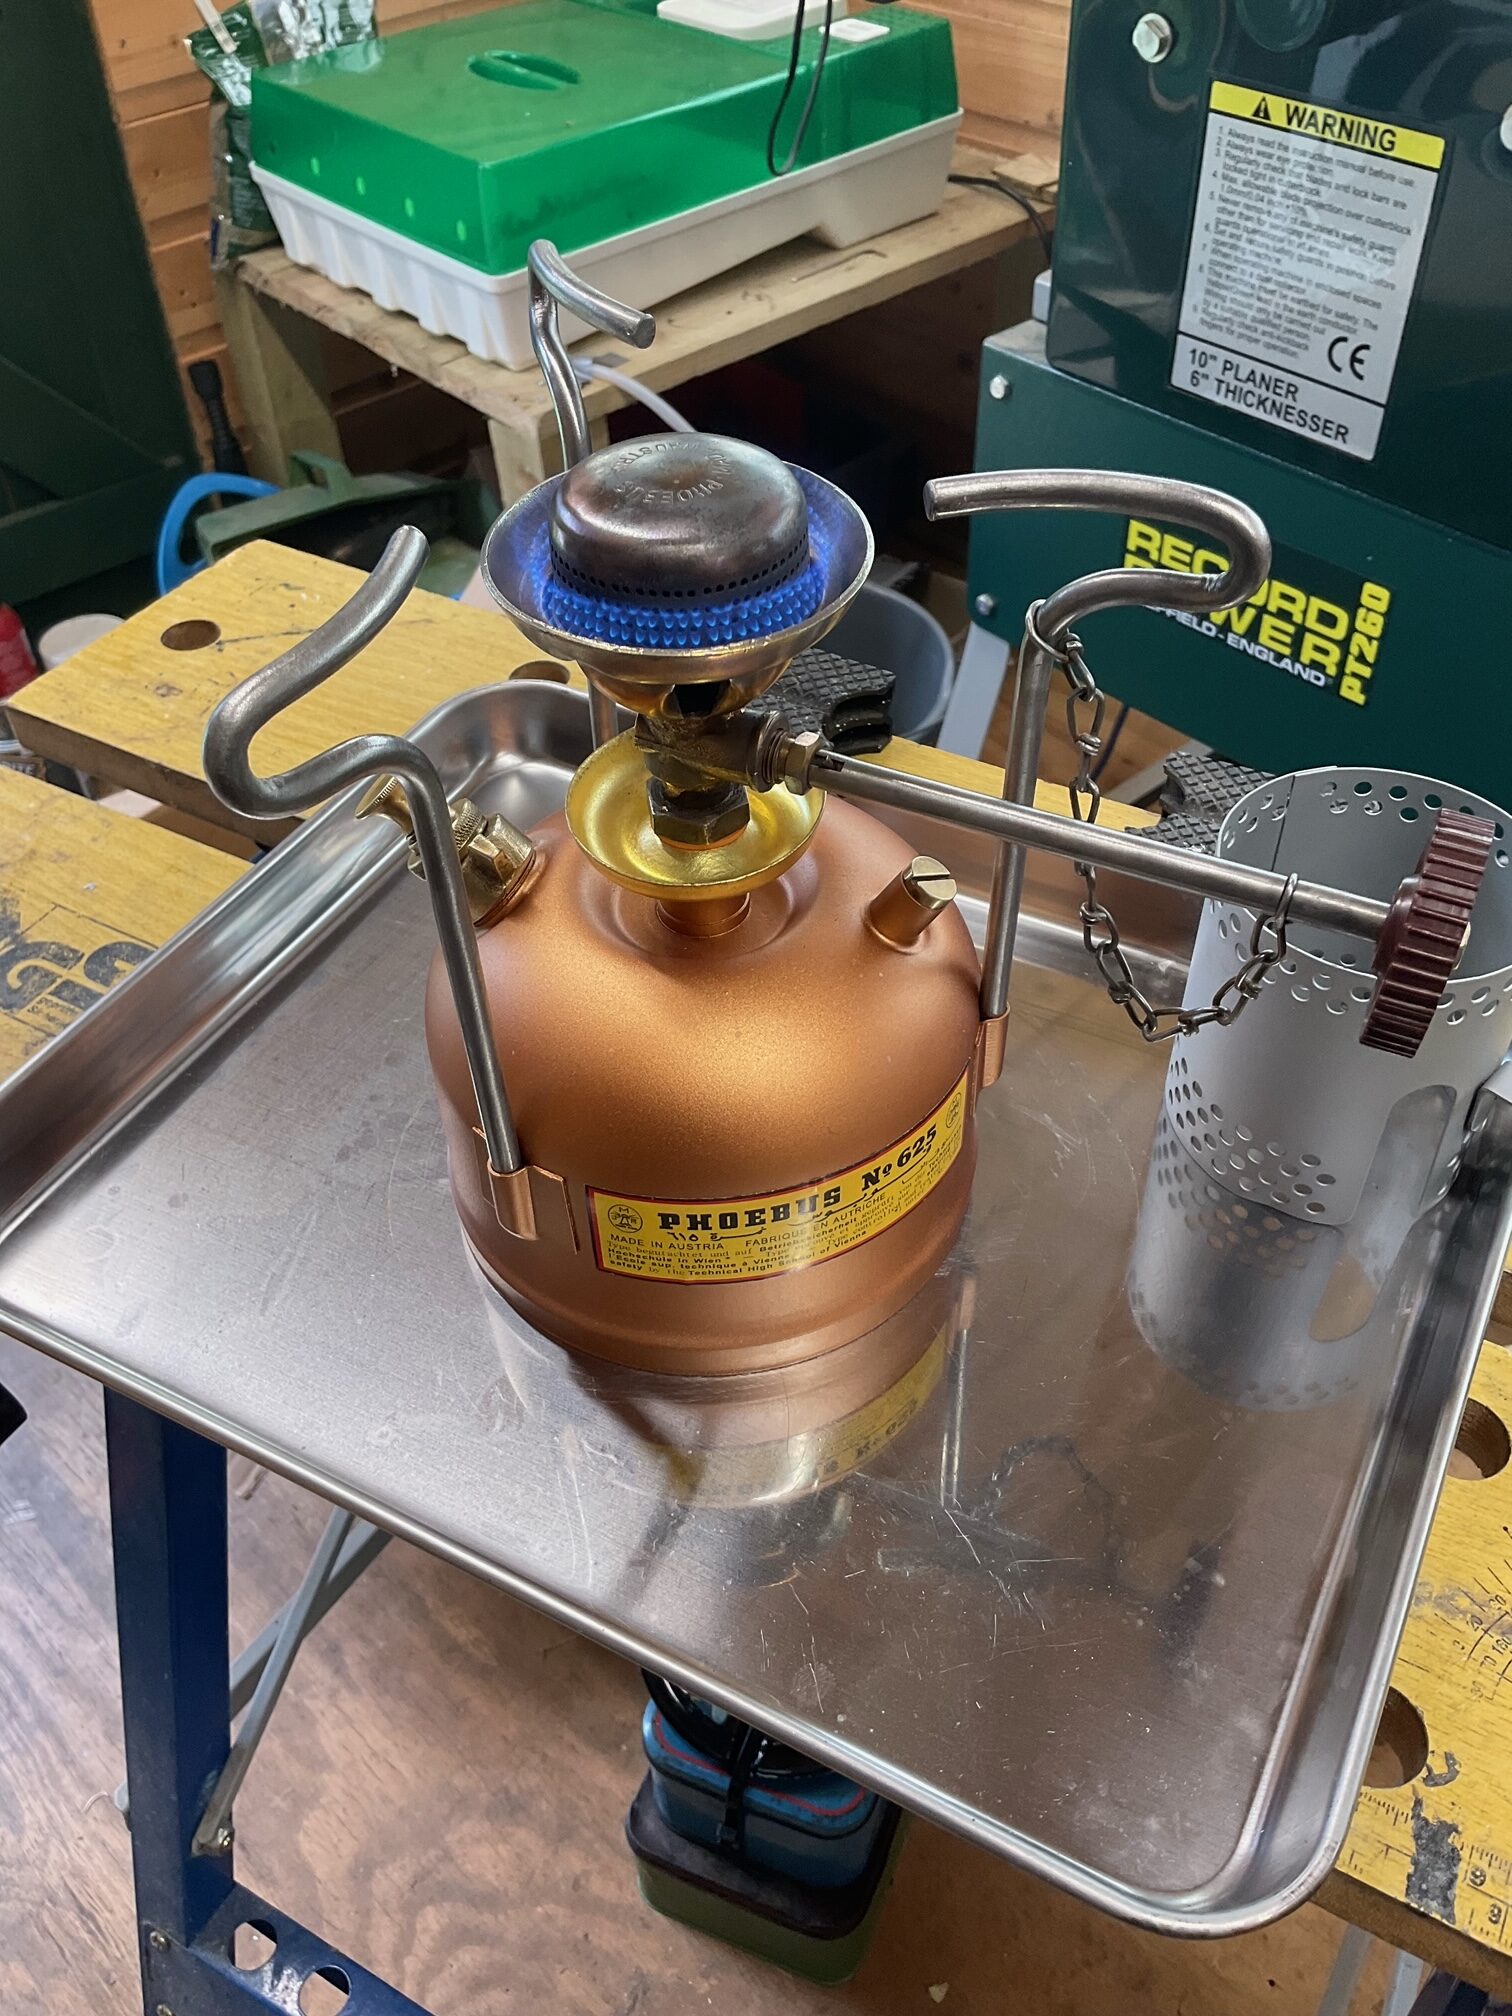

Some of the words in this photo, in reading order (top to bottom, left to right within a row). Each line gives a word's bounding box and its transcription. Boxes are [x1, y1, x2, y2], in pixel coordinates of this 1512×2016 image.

[1286, 103, 1396, 152] WARNING
[1221, 359, 1299, 402] PLANER
[1213, 378, 1349, 444] THICKNESSER
[1126, 519, 1349, 641] RECRD
[1227, 632, 1326, 687] ENGLAND
[1339, 581, 1391, 706] PT260
[657, 1186, 840, 1230] PHOEBUS
[897, 1123, 936, 1167] 625
[610, 1233, 645, 1247] MADE
[651, 1241, 663, 1249] IN
[669, 1242, 725, 1251] AUSTRIA
[745, 1227, 807, 1248] FABRIQUE
[814, 1220, 828, 1232] EN
[833, 1193, 886, 1224] AUTRICHE
[688, 1267, 742, 1276] Technical
